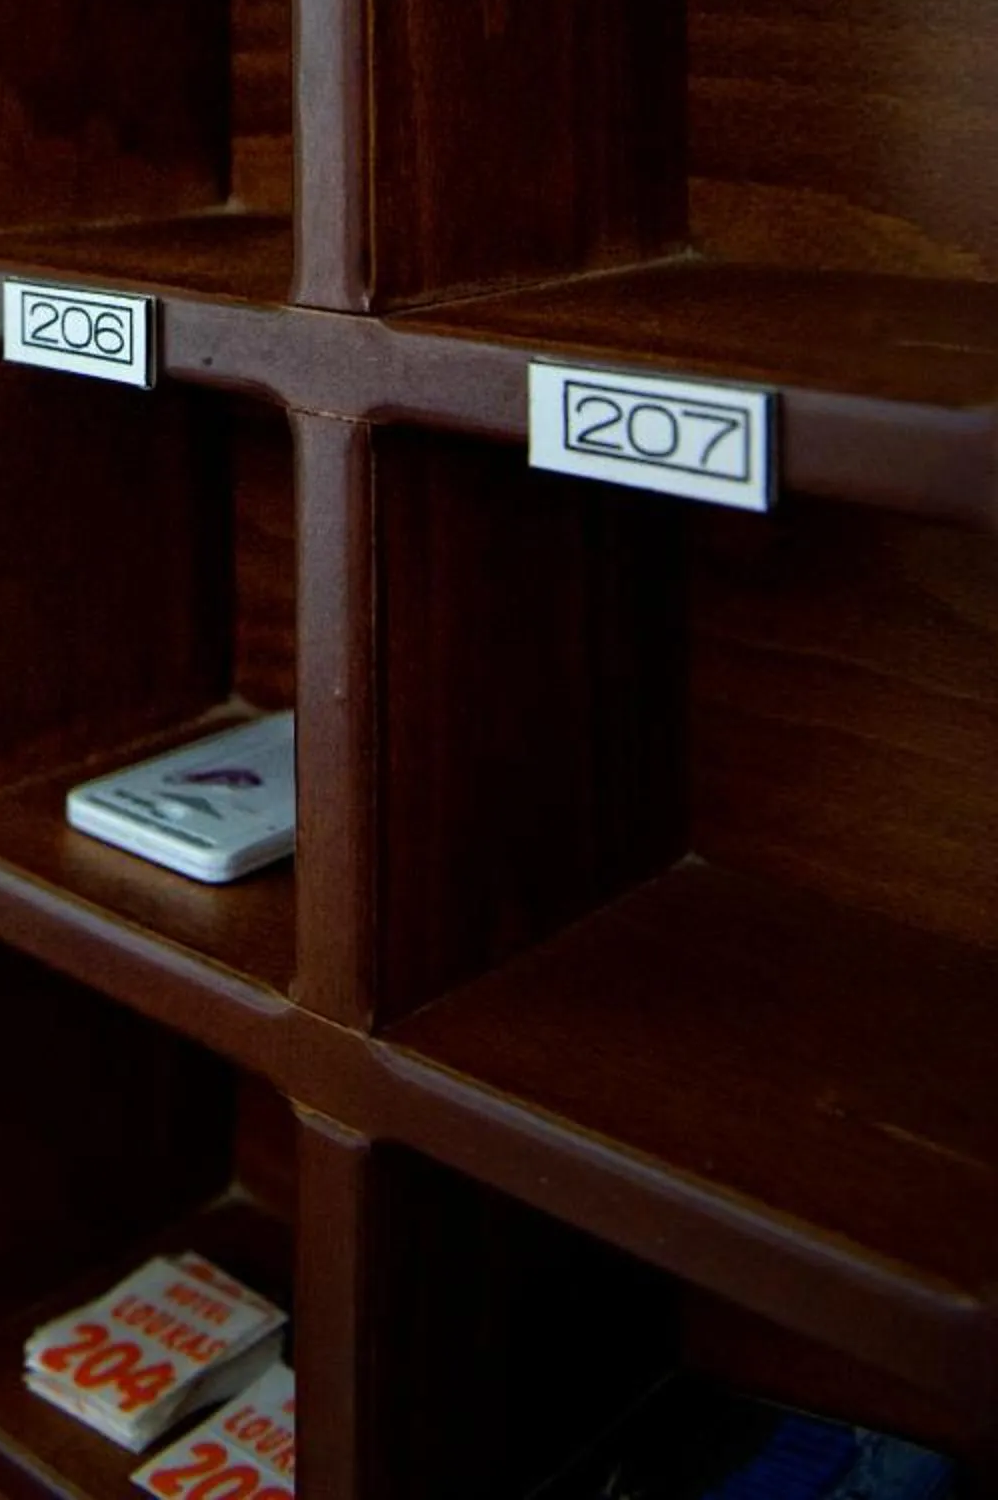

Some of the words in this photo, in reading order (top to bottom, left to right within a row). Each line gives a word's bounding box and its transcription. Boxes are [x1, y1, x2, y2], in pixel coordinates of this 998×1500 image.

[29, 302, 125, 356] 206
[575, 396, 740, 467] 207
[40, 1323, 176, 1413] 204
[149, 1442, 295, 1500] 20
